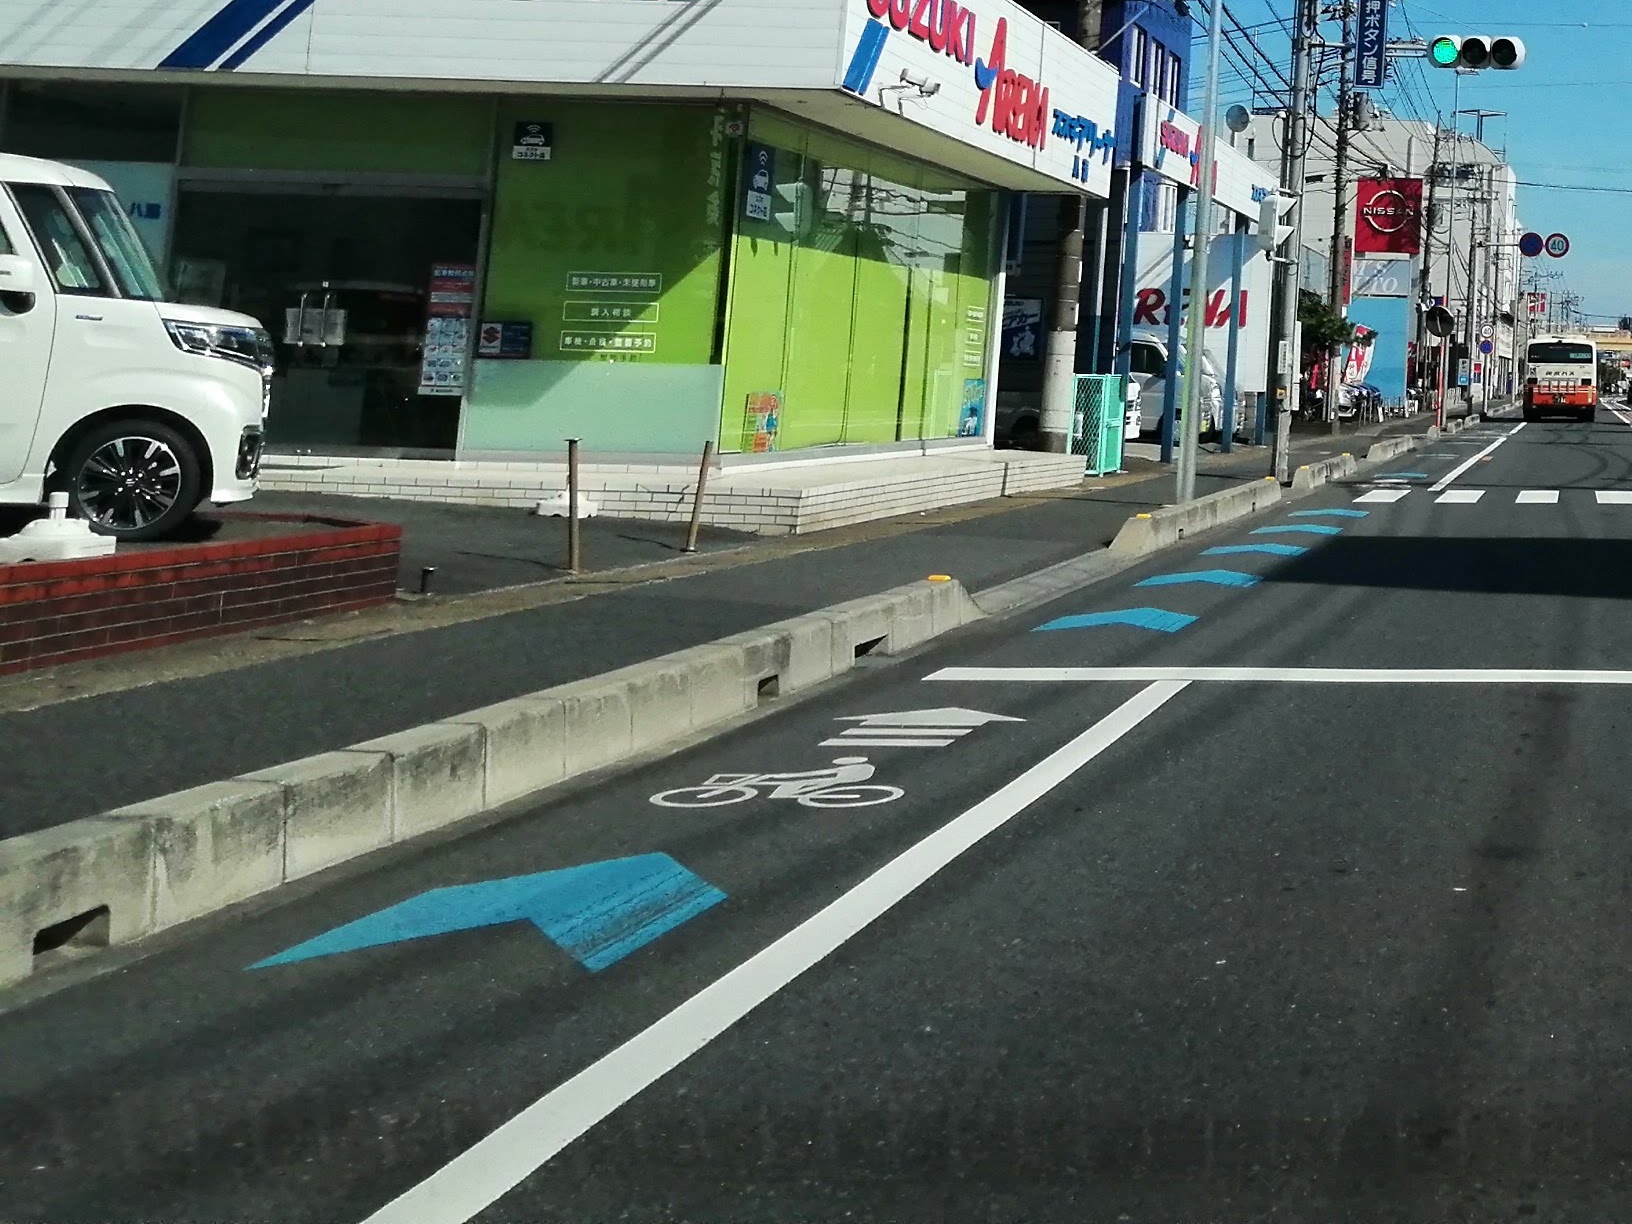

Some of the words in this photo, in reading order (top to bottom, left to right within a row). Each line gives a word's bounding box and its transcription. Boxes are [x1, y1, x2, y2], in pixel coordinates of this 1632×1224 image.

[1361, 0, 1382, 84] 押ボタン信号
[974, 16, 1050, 152] ARENA
[1363, 206, 1414, 217] NISSAN
[1551, 240, 1565, 251] 40
